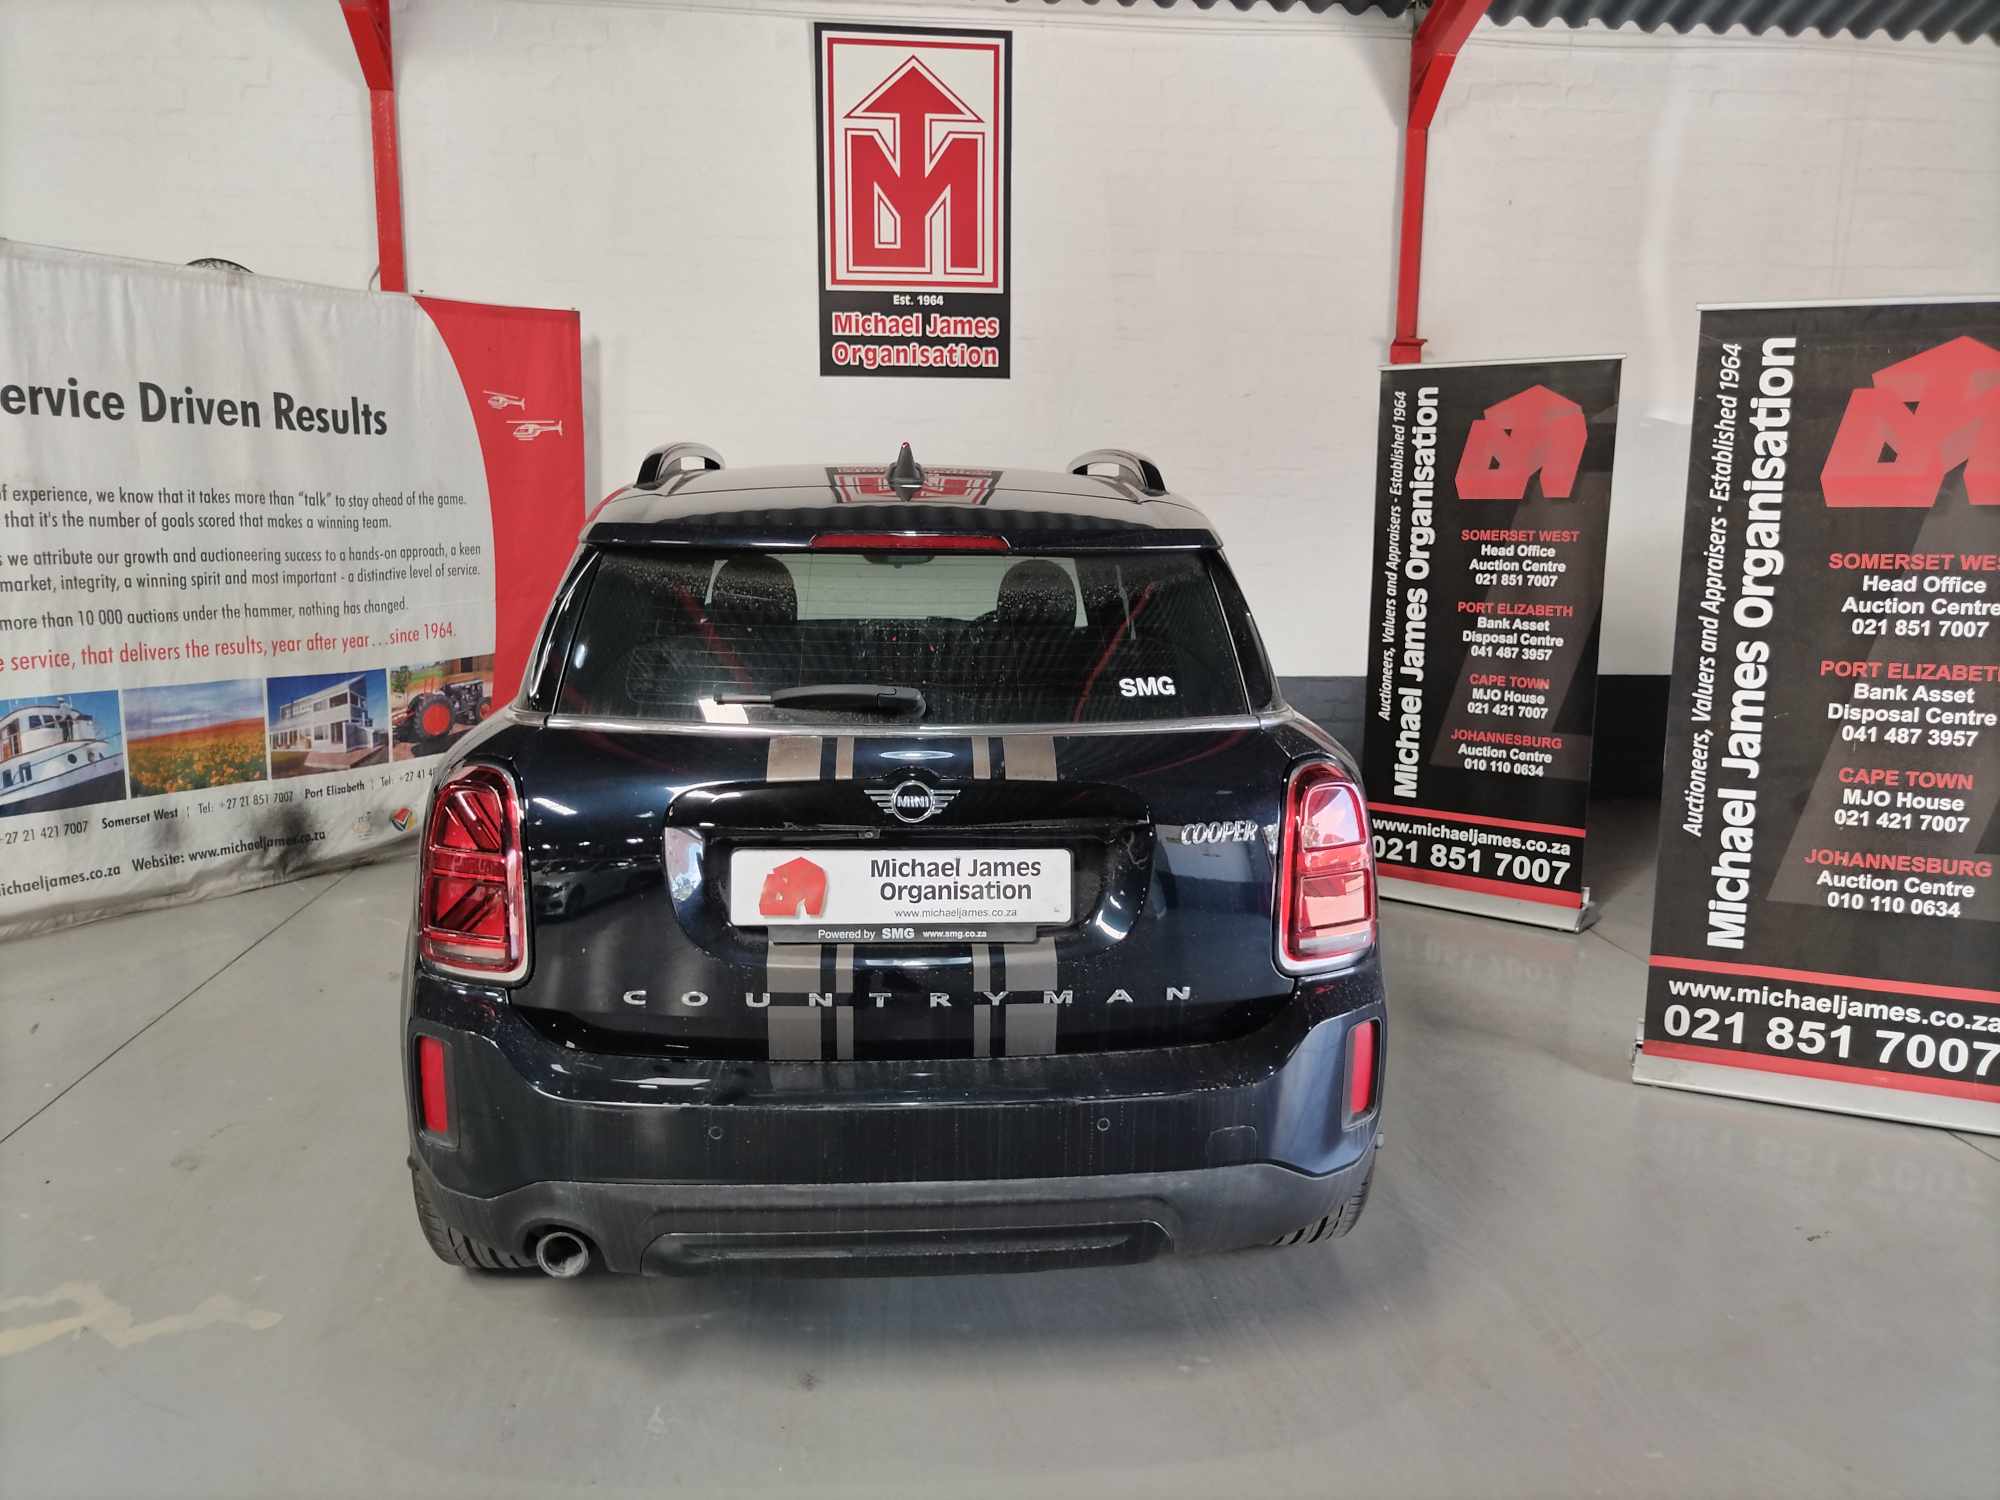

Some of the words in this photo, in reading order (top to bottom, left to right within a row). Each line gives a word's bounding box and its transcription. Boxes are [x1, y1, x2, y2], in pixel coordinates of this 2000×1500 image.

[893, 295, 914, 305] Est.
[917, 295, 944, 306] 1964
[832, 312, 922, 336] Michael
[926, 313, 1000, 338] James
[832, 341, 999, 369] Organisation
[1719, 343, 1742, 389] 1964
[138, 381, 261, 428] Driven
[273, 391, 388, 435] Results
[1394, 391, 1408, 421] 1964
[1389, 423, 1406, 496] Established
[1709, 394, 1738, 502] Established
[1405, 386, 1440, 580] Organisation
[1733, 337, 1797, 628] Organisation
[13, 486, 92, 506] experience,
[96, 490, 115, 503] we
[119, 487, 154, 503] know
[158, 488, 183, 504] that
[187, 488, 196, 504] it
[199, 488, 231, 505] takes
[234, 491, 266, 505] more
[269, 489, 295, 506] than
[335, 494, 345, 507] to
[348, 495, 369, 510] stay
[372, 491, 403, 507] ahead
[406, 491, 417, 506] of
[418, 491, 434, 506] the
[438, 495, 467, 509] game.
[5, 510, 34, 528] that
[62, 511, 84, 528] the
[88, 511, 140, 528] number
[144, 512, 157, 528] of
[161, 512, 195, 531] goals
[198, 512, 235, 528] scored
[239, 512, 263, 528] that
[267, 514, 303, 529] makes
[307, 518, 314, 529] a
[317, 515, 359, 532] winning
[362, 516, 392, 529] team.
[1386, 504, 1402, 570] Appraisers
[1461, 530, 1536, 542] SOMERSET
[1539, 530, 1580, 543] WEST
[1480, 544, 1514, 557] Head
[1517, 545, 1556, 558] Office
[1829, 552, 1954, 570] SOMERSET
[1960, 554, 2000, 571] WE
[1469, 559, 1520, 572] Auction
[1522, 560, 1567, 573] Centre
[1700, 516, 1727, 614] Appraisers
[1384, 571, 1399, 597] and
[1475, 573, 1497, 585] 021
[1500, 574, 1523, 586] 851
[1526, 575, 1558, 588] 7007
[1862, 575, 1917, 593] Head
[1923, 576, 1987, 594] Office
[1457, 601, 1494, 614] PORT
[1497, 603, 1574, 617] ELIZABETH
[1841, 596, 1924, 615] Auction
[1931, 598, 2000, 616] Centre
[1381, 598, 1398, 643] Valuers
[1477, 617, 1511, 630] Bank
[1514, 618, 1550, 632] Asset
[1852, 618, 1887, 635] 021
[1895, 619, 1931, 636] 851
[1939, 620, 1990, 638] 7007
[1400, 587, 1430, 682] James
[1463, 631, 1517, 647] Disposal
[1519, 632, 1565, 647] Centre
[1698, 615, 1719, 653] and
[11, 650, 75, 672] service,
[81, 644, 113, 665] that
[120, 642, 180, 663] delivers
[185, 639, 209, 659] the
[215, 636, 267, 657] results,
[271, 638, 301, 657] year
[307, 633, 336, 652] after
[424, 622, 457, 641] 1964.
[1470, 645, 1495, 658] 041
[1497, 646, 1519, 660] 487
[1521, 648, 1553, 662] 3957
[1469, 673, 1507, 687] CAPE
[1510, 676, 1550, 690] TOWN
[1820, 660, 1881, 678] PORT
[1888, 662, 2000, 682] ELIZABET
[1118, 676, 1176, 697] SMG
[1378, 647, 1397, 721] Auctioneers,
[1691, 656, 1716, 722] Valuers
[1854, 683, 1907, 701] Bank
[1912, 685, 1976, 704] Asset
[1472, 688, 1502, 701] MJO
[1504, 690, 1546, 705] House
[1467, 702, 1490, 715] 021
[1492, 703, 1515, 717] 421
[1517, 705, 1549, 720] 7007
[1721, 640, 1770, 779] James
[1828, 702, 1919, 725] Disposal
[1925, 707, 1998, 727] Centre
[1394, 687, 1424, 799] Michael
[1450, 728, 1563, 749] JOHANNESBURG
[1842, 725, 1877, 743] 041
[1884, 727, 1922, 745] 487
[1927, 729, 1979, 747] 3957
[1457, 743, 1507, 759] Auction
[1509, 748, 1553, 764] Centre
[1464, 757, 1487, 771] 010
[1489, 759, 1511, 773] 110
[1513, 761, 1544, 777] 0634
[1839, 767, 1899, 786] CAPE
[1905, 770, 1974, 790] TOWN
[1682, 727, 1714, 838] Auctioneers,
[23, 829, 35, 842] 21
[40, 825, 59, 840] 421
[63, 820, 89, 836] 7007
[101, 813, 151, 830] Somerset
[153, 808, 179, 822] West
[304, 786, 323, 800] Port
[326, 781, 365, 796] Elizabeth
[896, 795, 932, 808] MINI
[1843, 788, 1891, 807] MJO
[1896, 791, 1965, 812] House
[1834, 808, 1870, 827] 021
[1876, 811, 1912, 830] 421
[1920, 814, 1970, 833] 7007
[1181, 820, 1258, 846] COOPER
[1372, 816, 1571, 857] www.michaeljames.co.za
[132, 852, 185, 873] Website:
[870, 857, 960, 878] Michael
[968, 858, 1041, 878] James
[1372, 835, 1419, 864] 021
[1430, 843, 1482, 873] 851
[1494, 852, 1572, 886] 7007
[1706, 788, 1757, 950] Michael
[1804, 849, 1993, 878] JOHANNESBURG
[880, 880, 1032, 903] Organisation
[1816, 870, 1898, 892] Auction
[1903, 876, 1976, 898] Centre
[895, 907, 1017, 918] www.michaeljames.co.za
[1827, 891, 1863, 910] 010
[1870, 895, 1904, 914] 110
[1910, 898, 1961, 918] 0634
[818, 928, 860, 940] Powered
[863, 928, 876, 941] by
[882, 927, 915, 939] SMG
[923, 929, 987, 939] www.smg.co.za
[623, 986, 1191, 1008] COUNTRYMAN
[1669, 980, 2000, 1033] www.michaeljames.co.za
[1664, 1004, 1745, 1045] 021
[1766, 1016, 1851, 1059] 851
[1874, 1029, 2000, 1077] 7007
